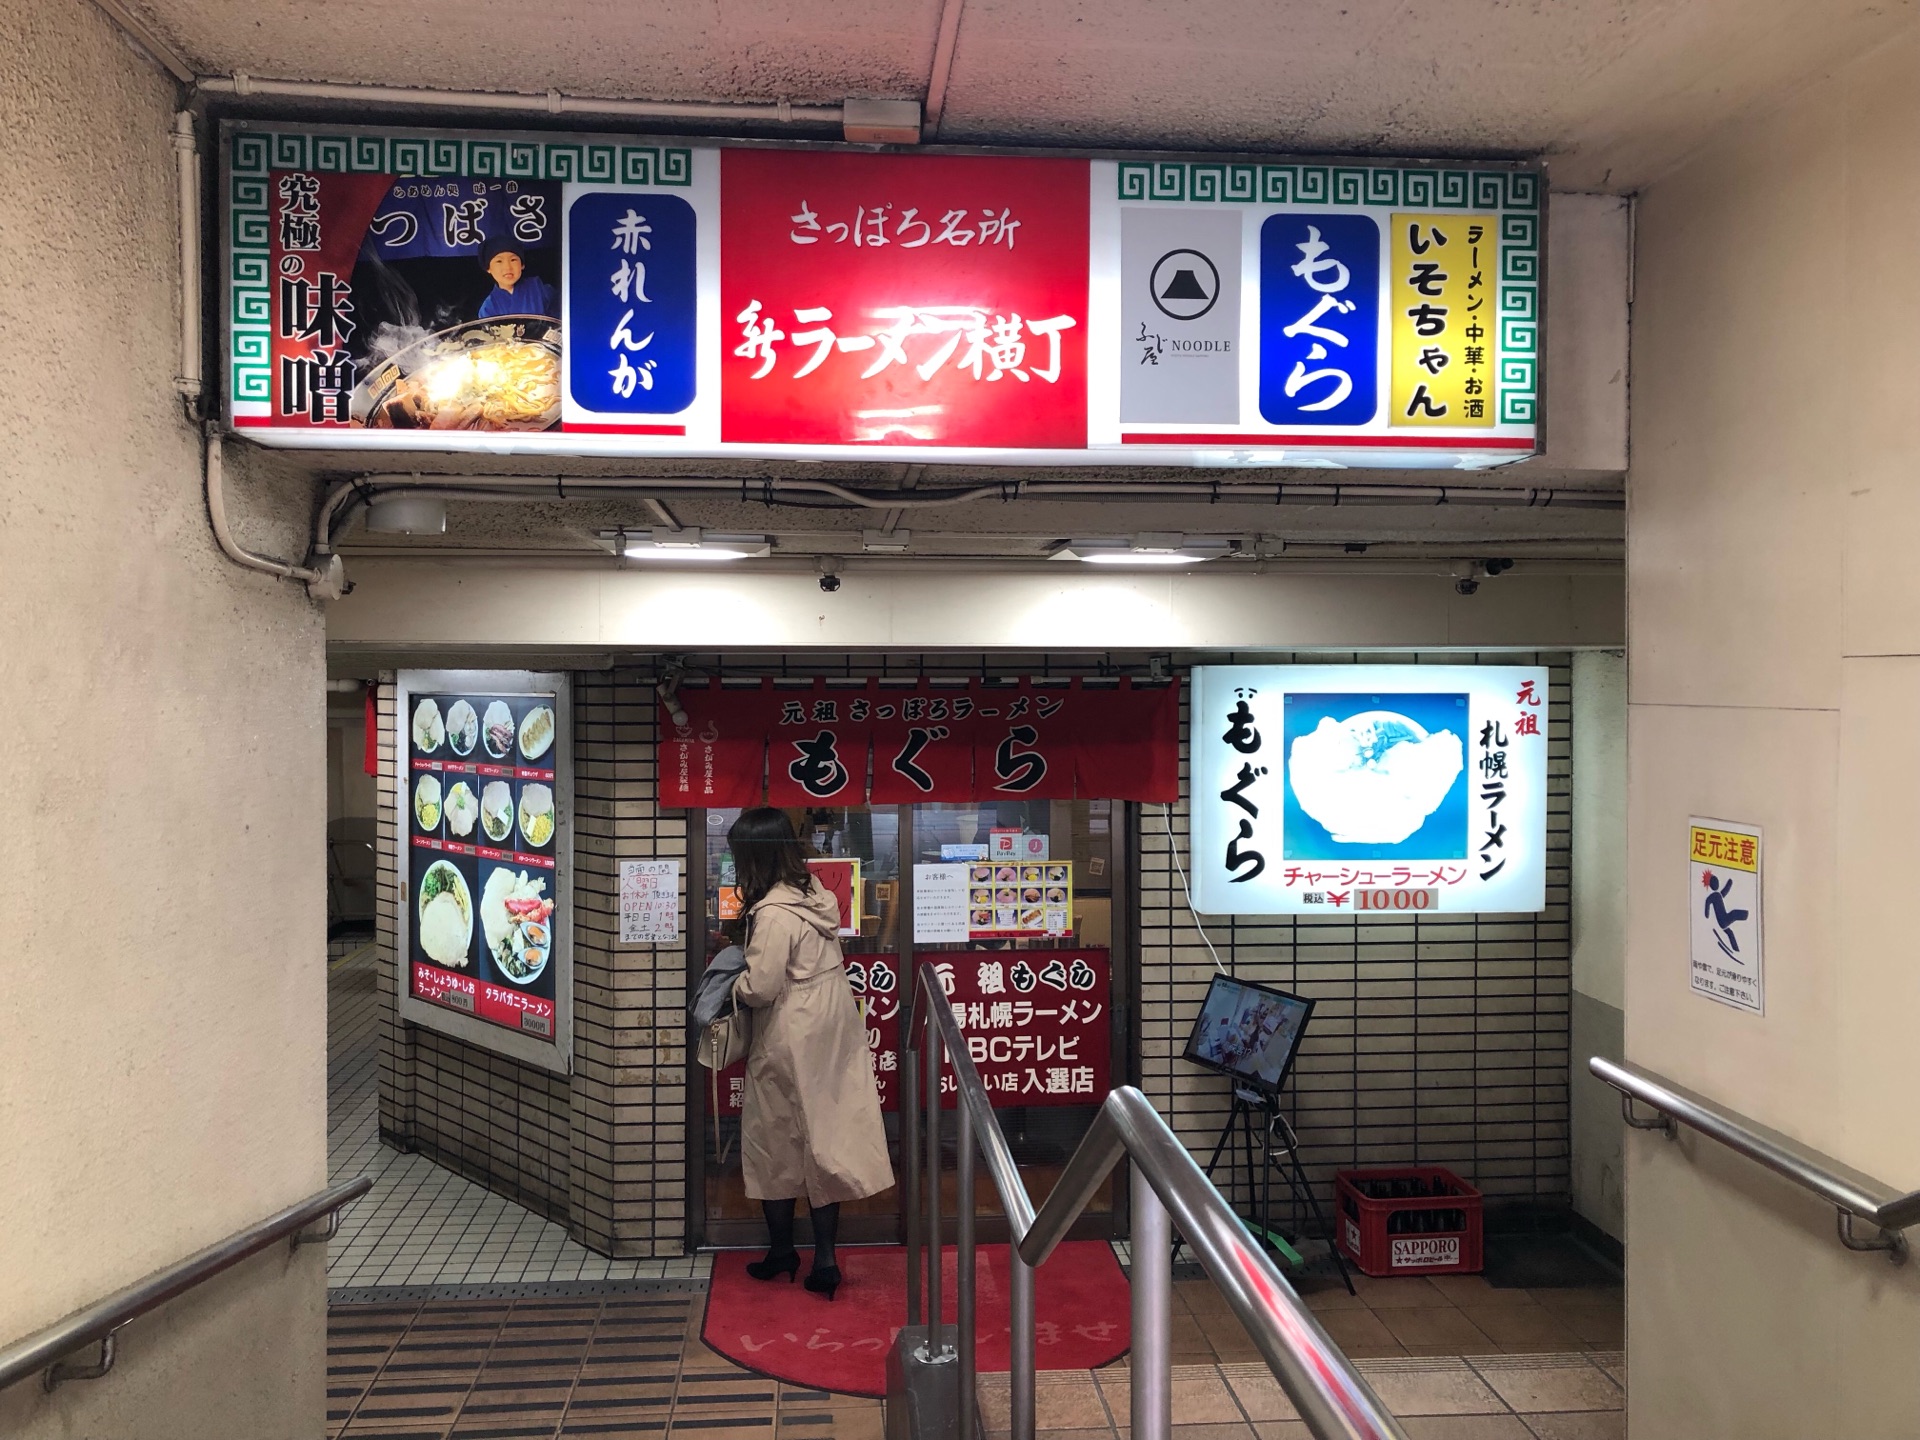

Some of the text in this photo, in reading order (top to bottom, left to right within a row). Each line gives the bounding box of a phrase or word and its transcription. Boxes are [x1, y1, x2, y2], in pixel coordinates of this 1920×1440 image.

[370, 194, 547, 248] つばさ
[790, 200, 1022, 250] さっぽろ名所
[278, 173, 355, 424] 究極の味噌
[610, 208, 657, 399] 赤れんが
[1283, 225, 1357, 412] もぐら
[1408, 223, 1448, 419] いそちゃん
[1463, 225, 1486, 419] ラーメン・中華・お酒
[735, 299, 1077, 384] 新ラーメン横丁
[1171, 340, 1231, 352] NOODLE
[779, 696, 1065, 725] 元祖 さっぽろラーメン
[1514, 680, 1541, 737] 元祖
[788, 725, 1049, 798] もぐら
[1220, 700, 1269, 883] もぐら
[1479, 720, 1509, 882] 札幌ラーメン
[1283, 867, 1467, 886] チャーシューラーメン
[1693, 831, 1756, 866] 足元注意
[624, 902, 652, 912] OPEN
[1394, 1239, 1457, 1255] SAPPORO
